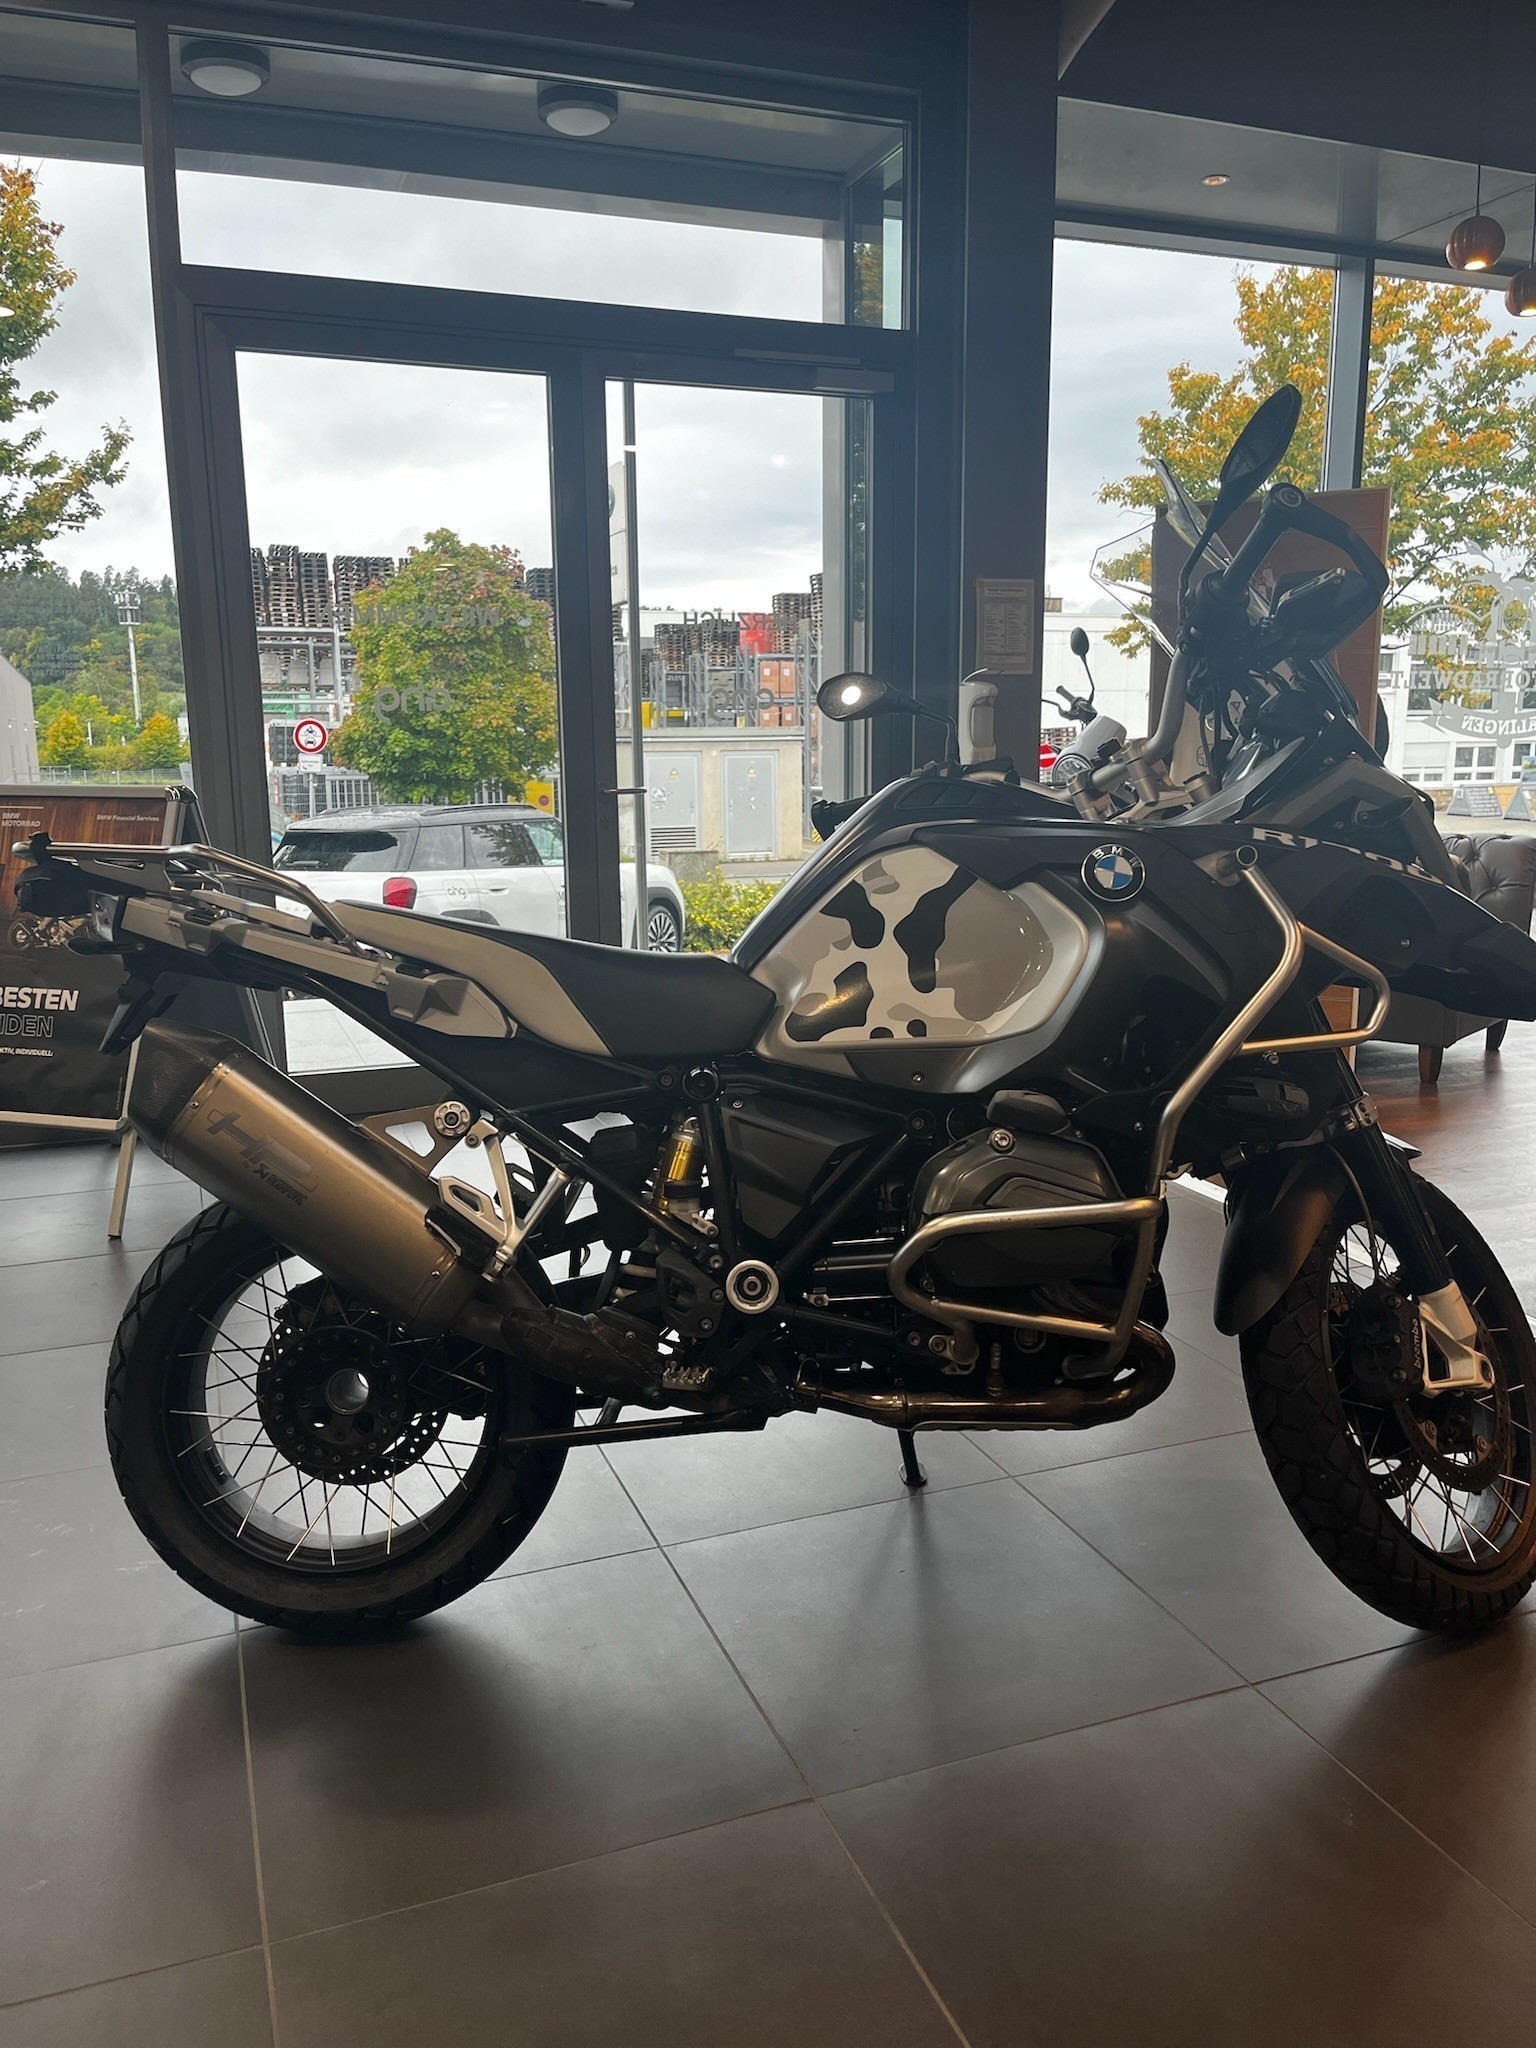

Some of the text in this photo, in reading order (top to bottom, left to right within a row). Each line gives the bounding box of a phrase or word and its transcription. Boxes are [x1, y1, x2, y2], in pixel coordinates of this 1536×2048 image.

[1, 820, 41, 828] MOTORRAD
[1092, 845, 1142, 868] BMW
[447, 886, 467, 899] ahg
[0, 986, 79, 1011] ESTEN
[1411, 1318, 1421, 1369] brembo
